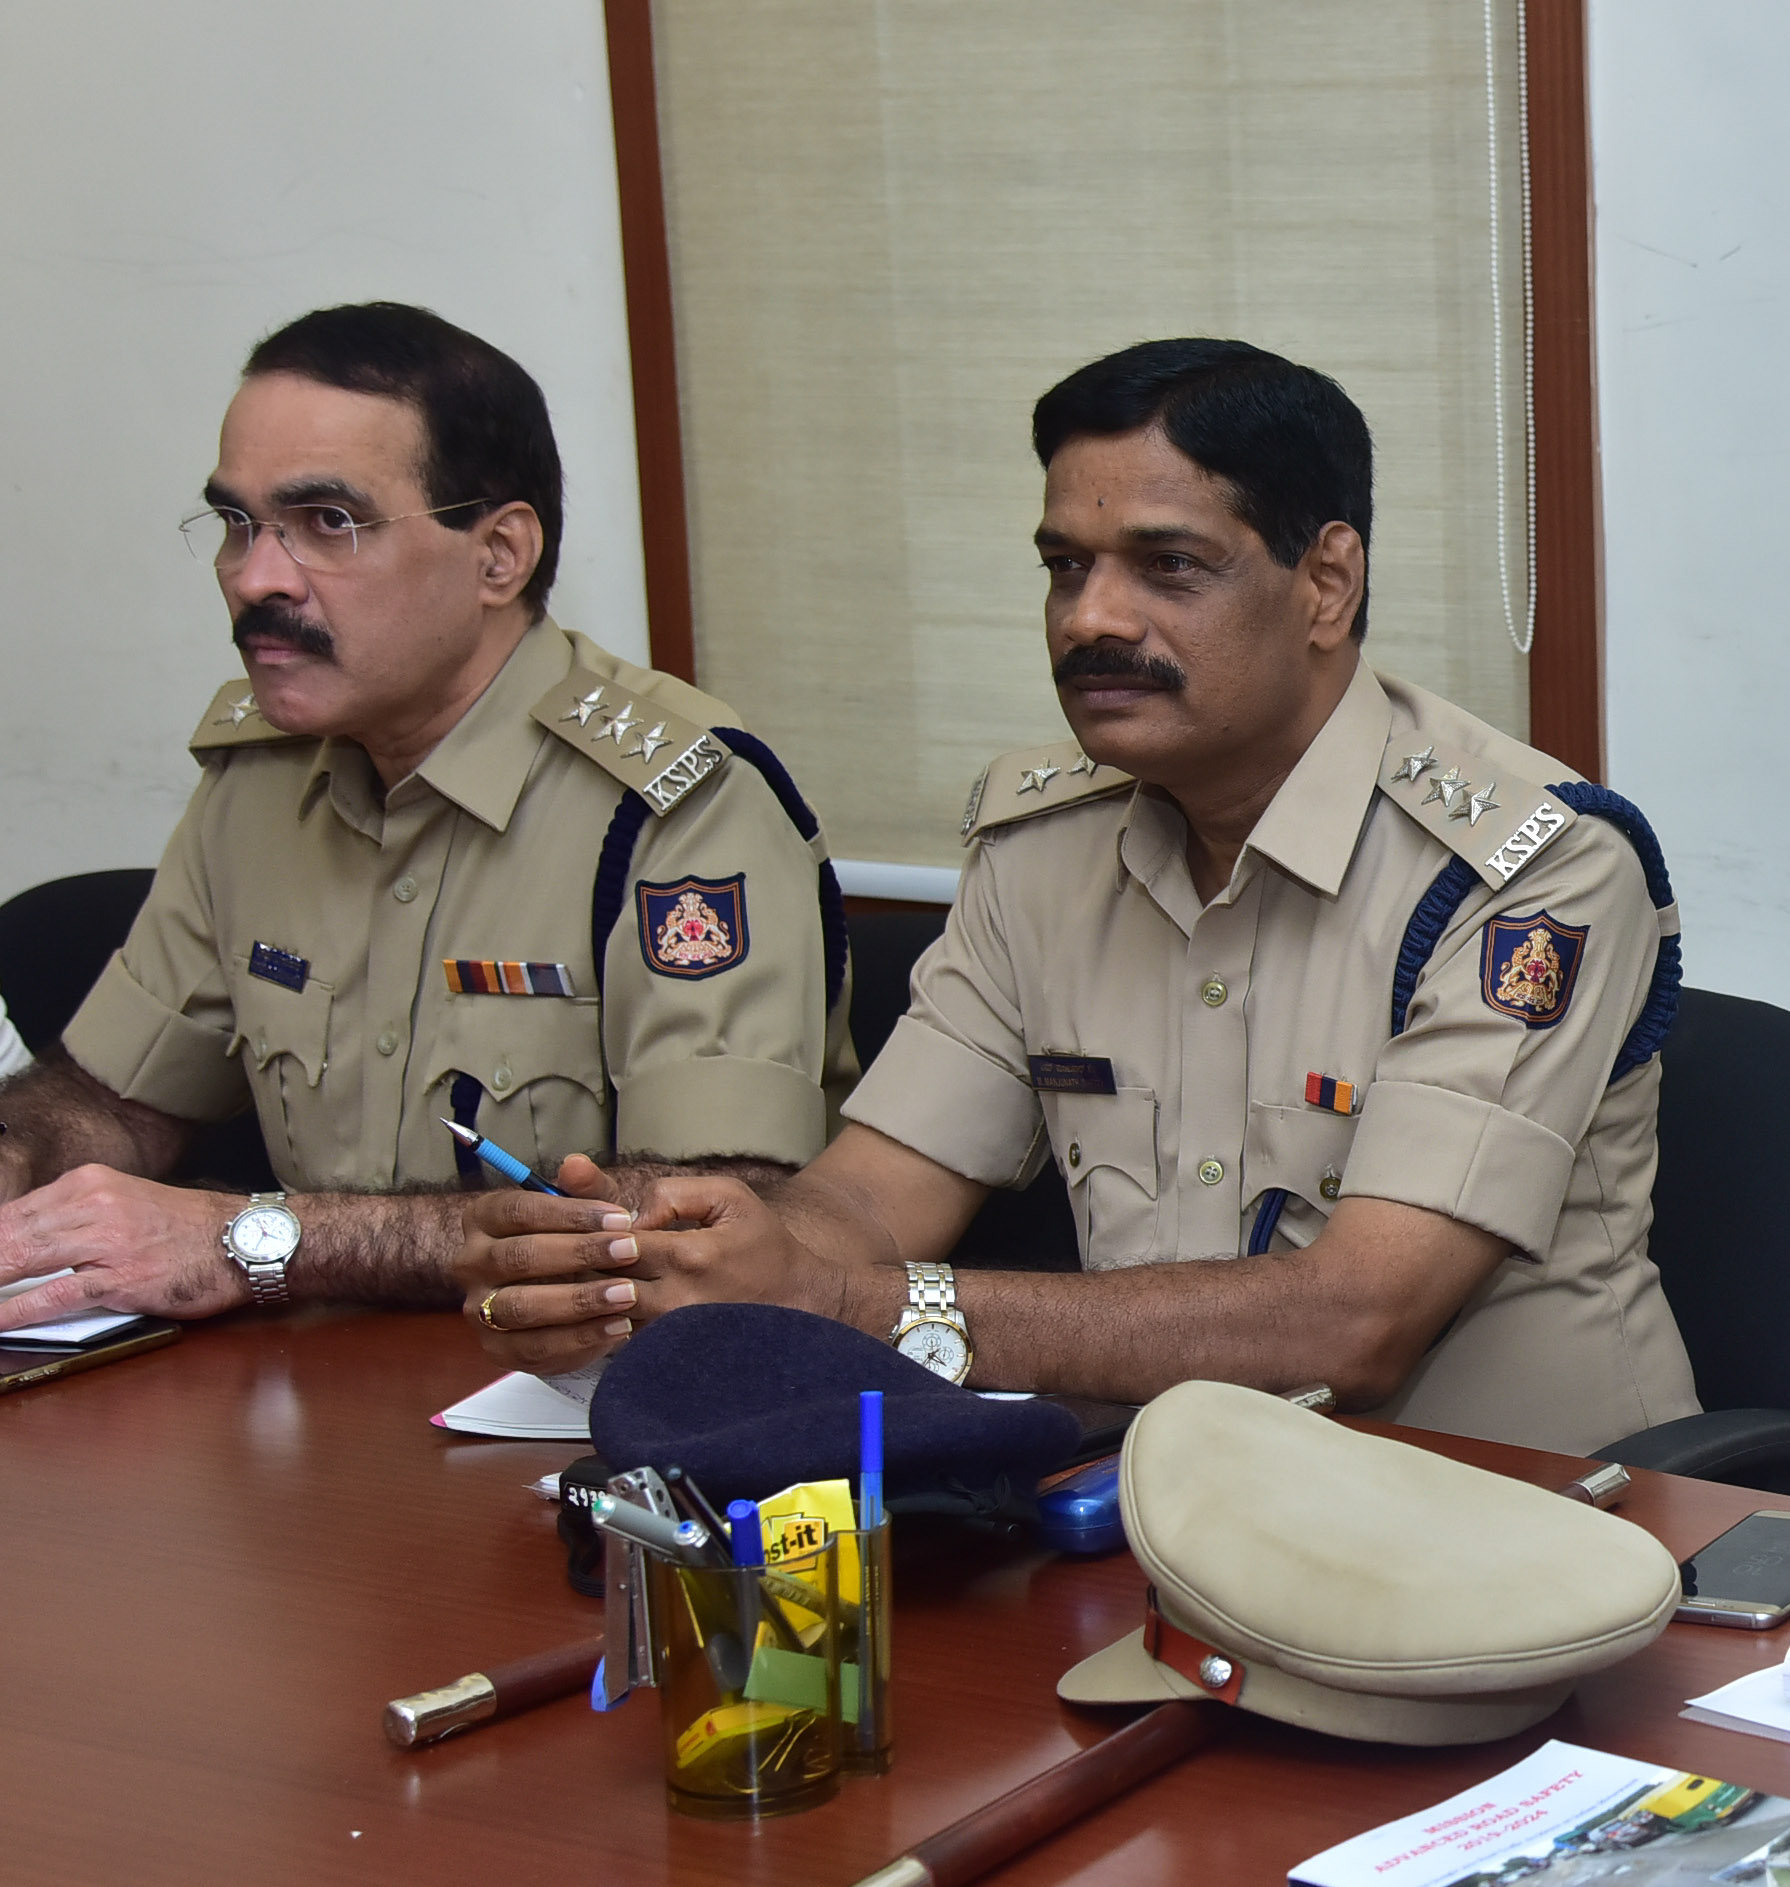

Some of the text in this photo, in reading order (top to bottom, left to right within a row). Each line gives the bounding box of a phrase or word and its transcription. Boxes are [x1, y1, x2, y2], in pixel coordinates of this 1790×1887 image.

[643, 735, 724, 811] KSPS
[1484, 802, 1565, 882] KSPS
[1519, 1769, 1584, 1808] SAFETY
